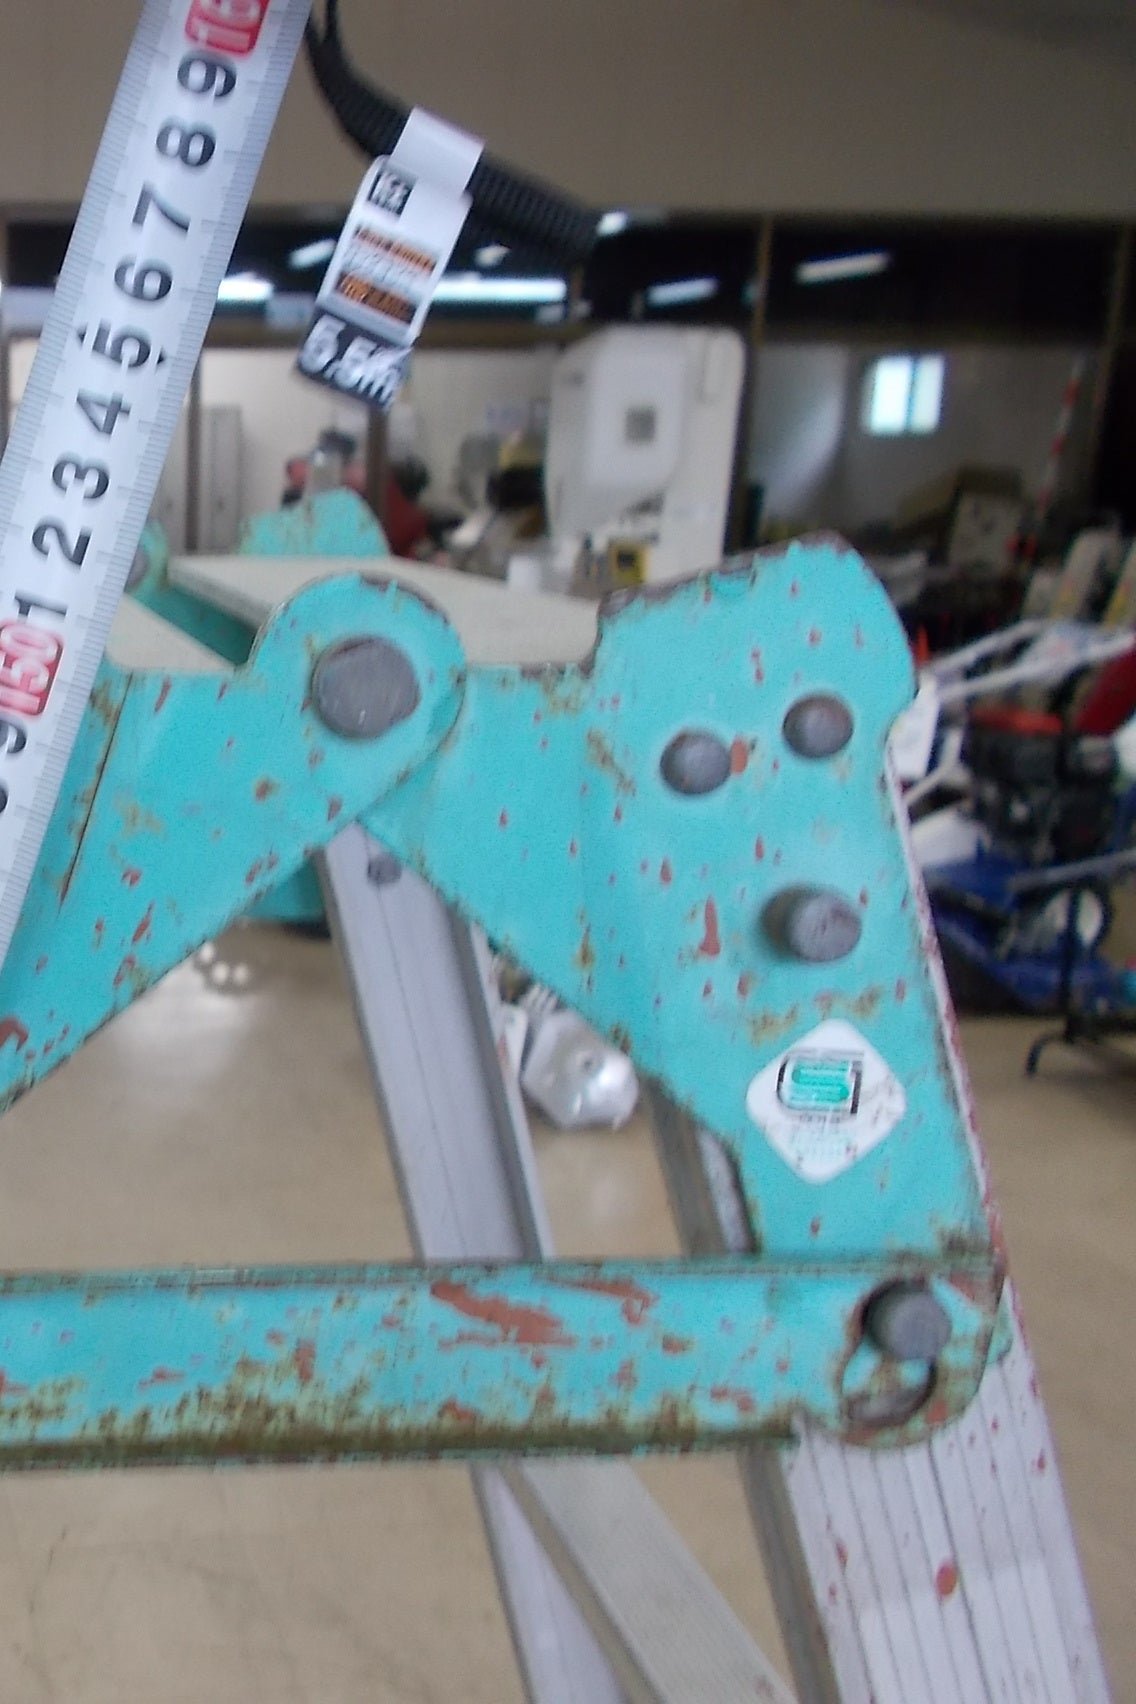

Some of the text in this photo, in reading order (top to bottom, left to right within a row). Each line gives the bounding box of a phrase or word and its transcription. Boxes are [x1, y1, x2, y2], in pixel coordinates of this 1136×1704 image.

[190, 0, 263, 46] 16
[177, 50, 237, 98] 9
[156, 120, 216, 167] 8
[132, 182, 191, 232] 7
[115, 255, 172, 301] 6
[92, 319, 151, 368] 5
[76, 389, 131, 436] 4
[52, 452, 110, 499] 3
[32, 516, 92, 567] 2
[15, 593, 67, 619] 1
